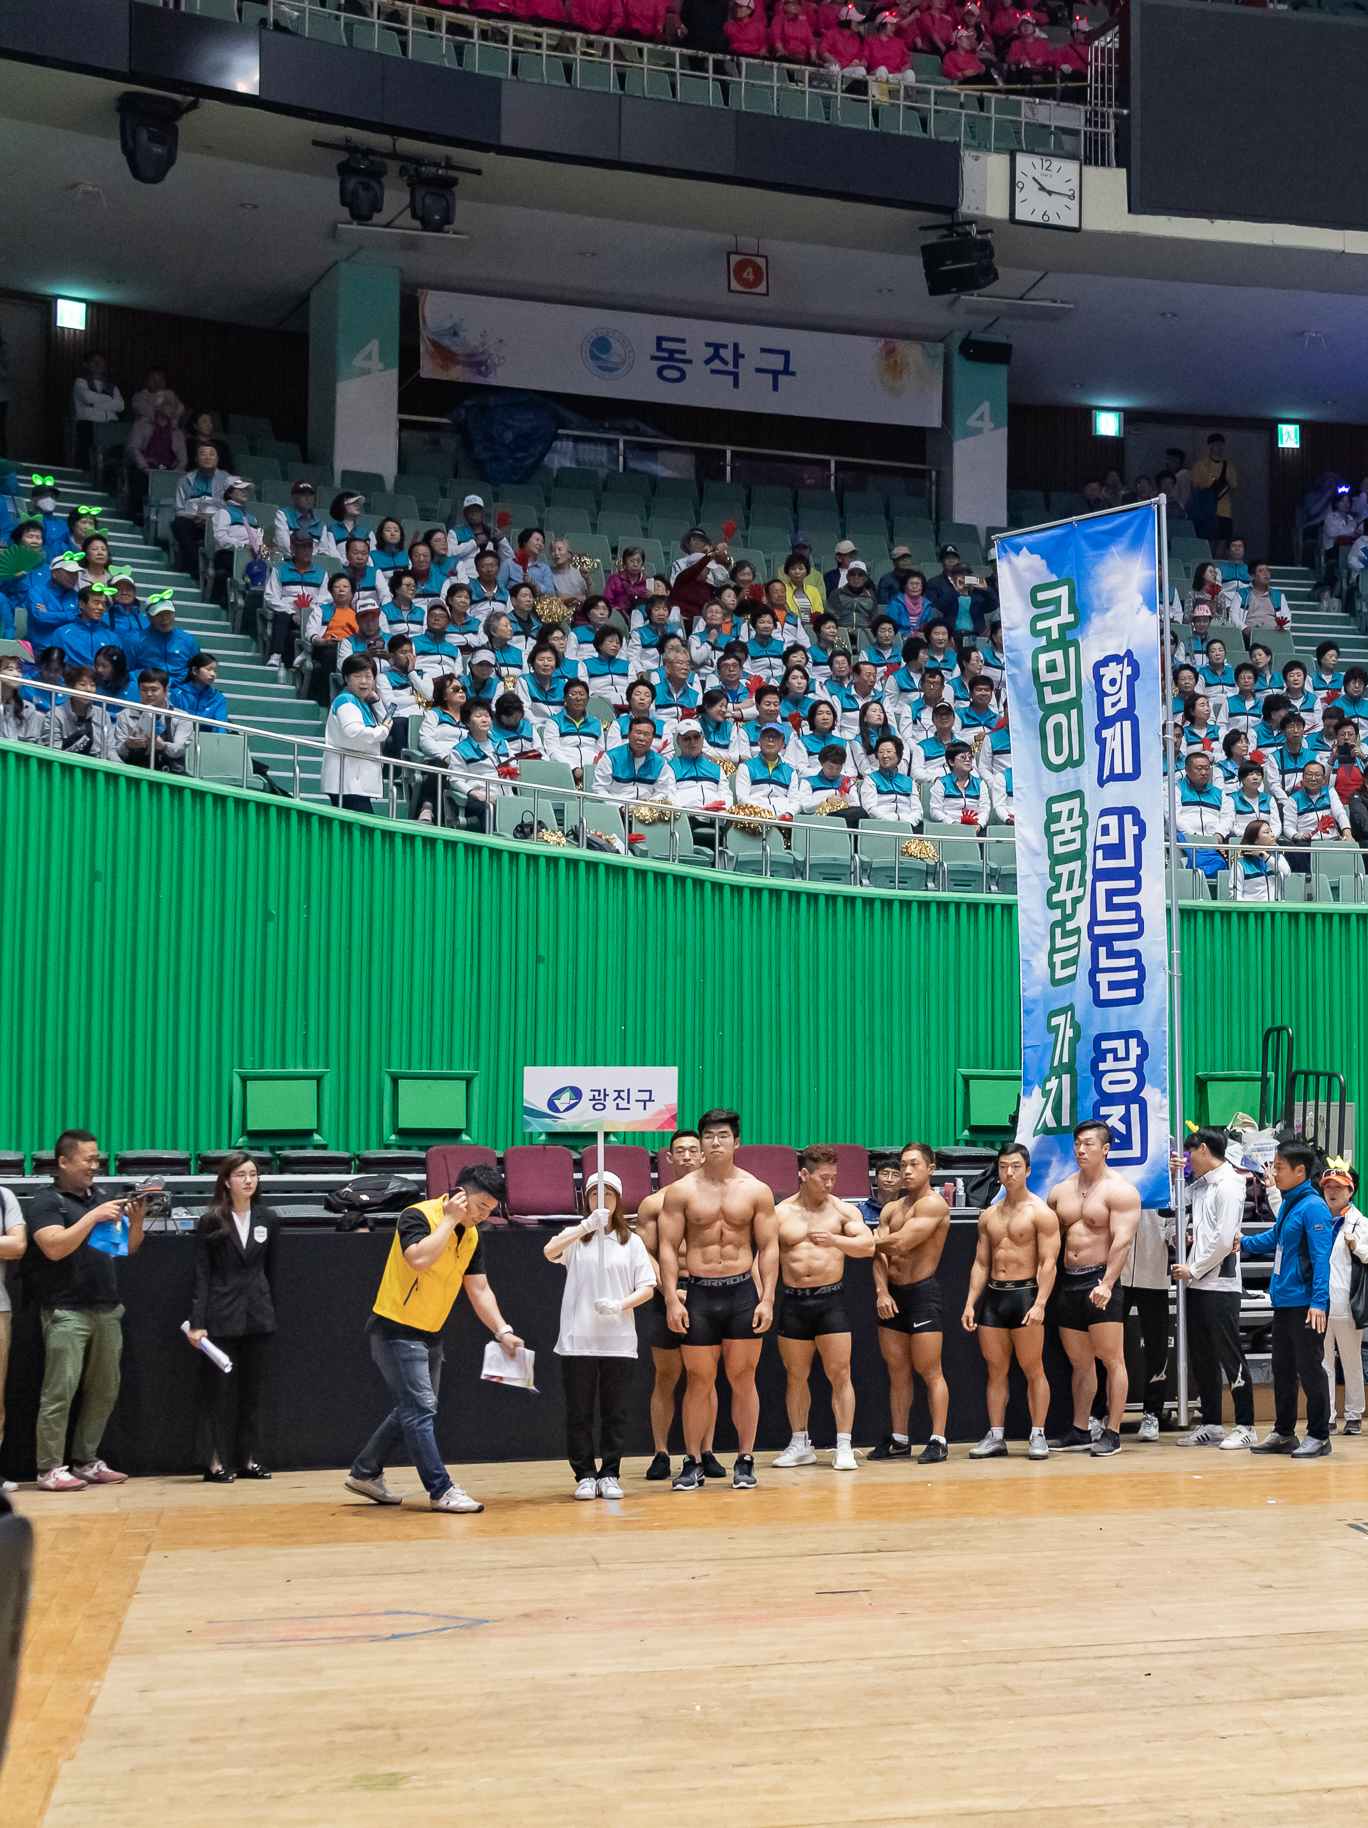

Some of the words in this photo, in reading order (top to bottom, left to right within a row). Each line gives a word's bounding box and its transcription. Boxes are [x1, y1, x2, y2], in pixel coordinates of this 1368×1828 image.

[1040, 158, 1053, 172] 12
[1016, 181, 1025, 193] 9
[1068, 188, 1076, 201] 3
[1041, 210, 1051, 222] 6
[742, 266, 755, 282] 4
[351, 338, 385, 376] 4
[650, 335, 797, 393] 동작구
[966, 400, 995, 437] 4
[1034, 581, 1082, 768] 구민이
[1097, 655, 1136, 782] 함께
[1048, 794, 1086, 982] 꿈꾸는
[1093, 812, 1140, 1001] 만드는
[1037, 1008, 1075, 1131] 가치
[588, 1088, 656, 1112] 광진구
[1098, 1036, 1143, 1160] 광진
